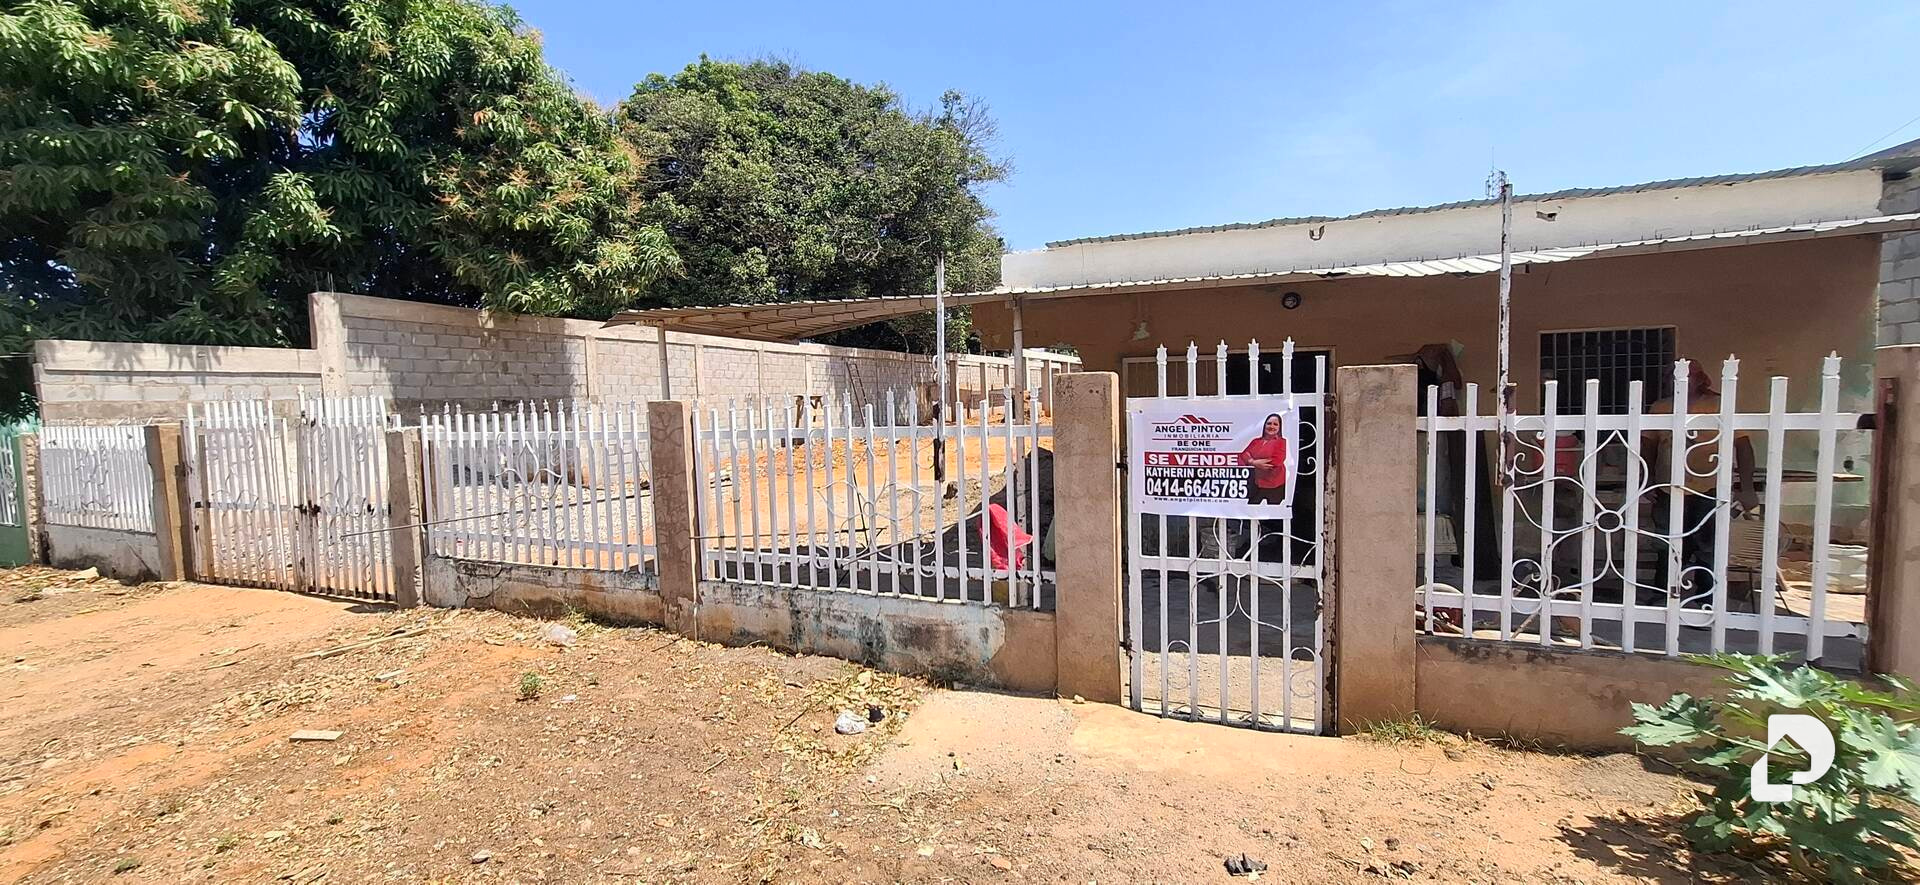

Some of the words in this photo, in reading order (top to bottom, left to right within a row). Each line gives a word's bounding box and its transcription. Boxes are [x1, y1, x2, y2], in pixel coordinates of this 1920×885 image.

[1155, 425, 1187, 433] ANGEL
[1191, 425, 1230, 433] PINTON
[1148, 454, 1170, 465] SE
[1175, 454, 1238, 465] VENDE
[1146, 467, 1194, 478] KATHERIN
[1197, 468, 1250, 478] GARRILLO
[1147, 478, 1248, 498] 0414-6645785
